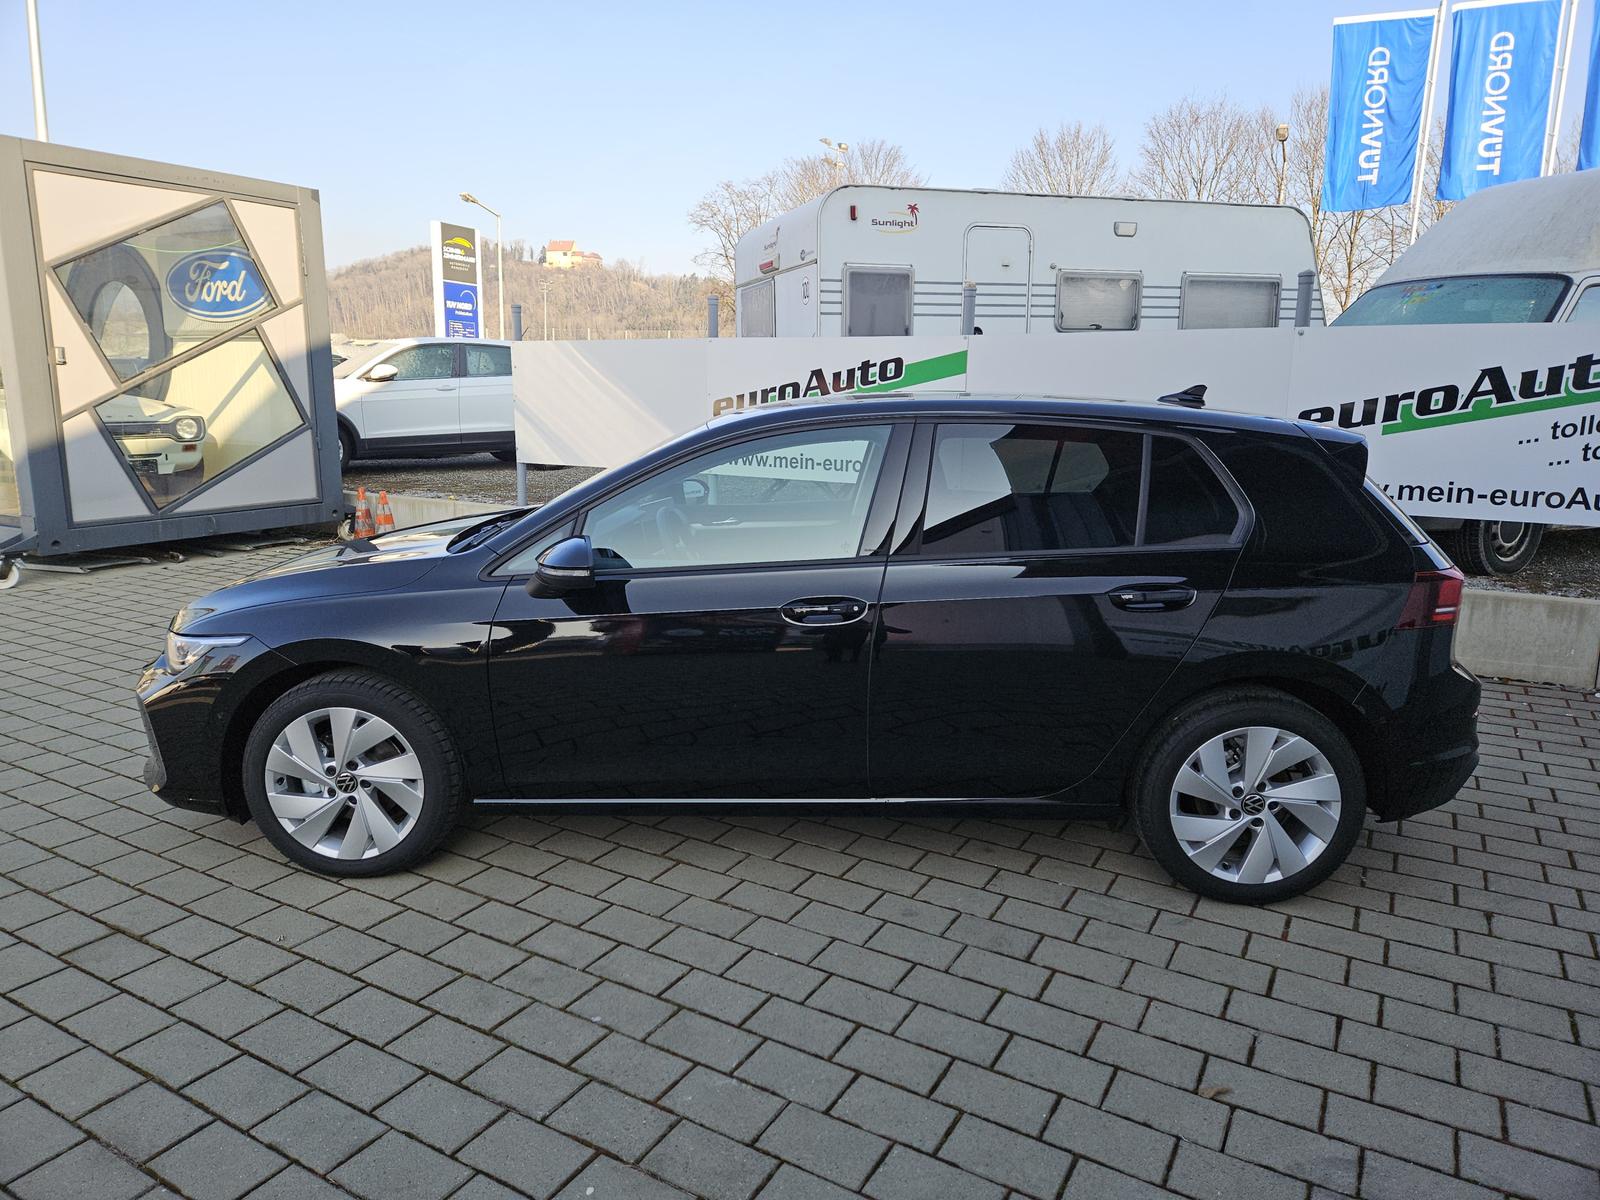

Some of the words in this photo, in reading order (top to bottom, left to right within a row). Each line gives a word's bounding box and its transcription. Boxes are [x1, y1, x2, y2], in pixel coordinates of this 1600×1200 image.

[871, 218, 914, 229] Sunlight
[185, 260, 247, 303] Ford
[712, 357, 904, 417] euroAuto
[1382, 481, 1600, 512] .mein-euroA
